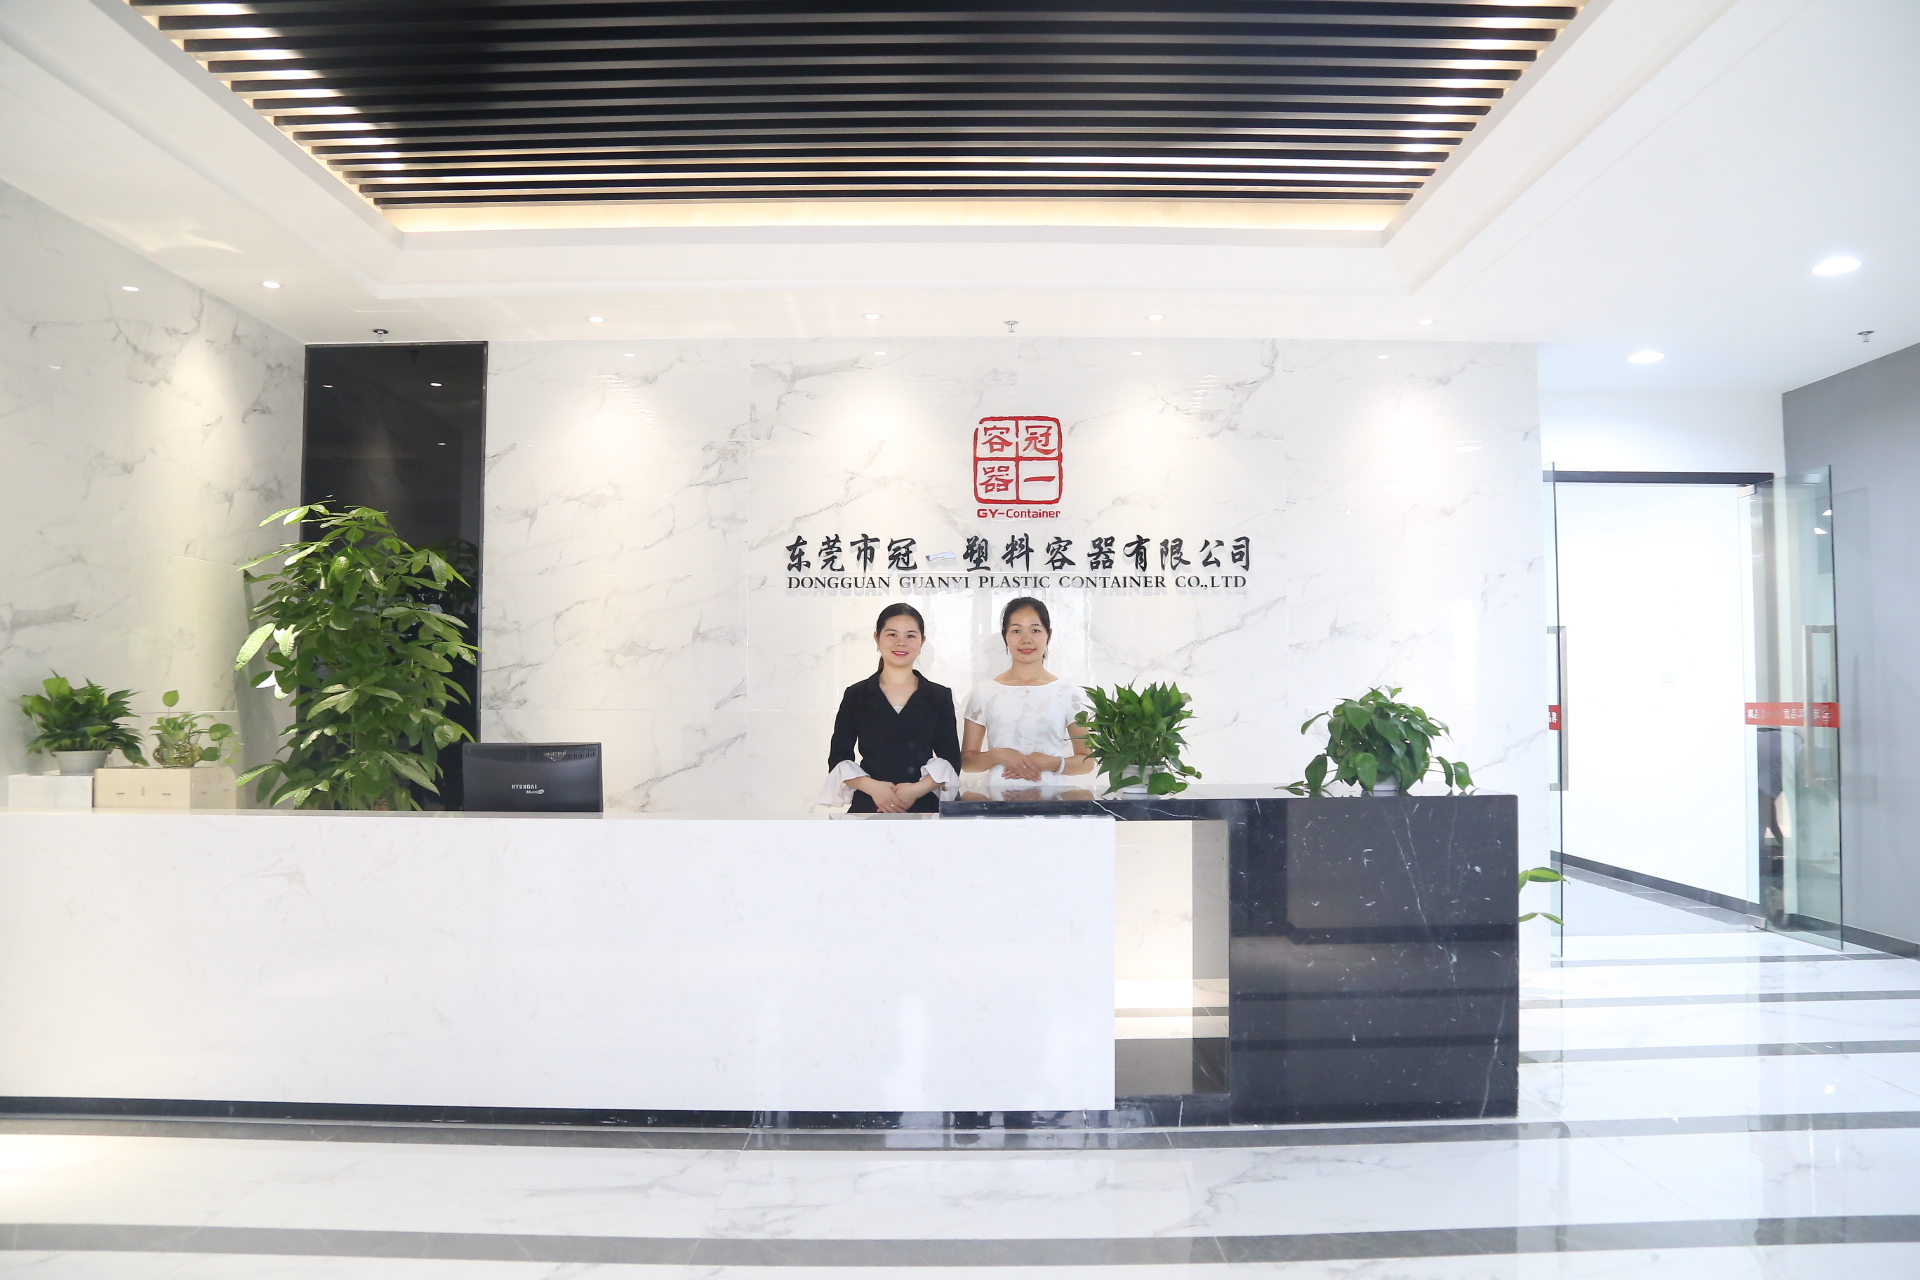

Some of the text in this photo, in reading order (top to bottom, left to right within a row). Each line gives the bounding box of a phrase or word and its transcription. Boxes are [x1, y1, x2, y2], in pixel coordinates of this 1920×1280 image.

[977, 508, 1061, 518] GY-Container
[786, 533, 1251, 573] 东莞市冠一塑料容器有限公司
[787, 576, 890, 589] DONGGUAN
[899, 576, 970, 589] GUANYI
[978, 575, 1051, 589] PLASTIC
[1058, 575, 1167, 589] CONTAINER
